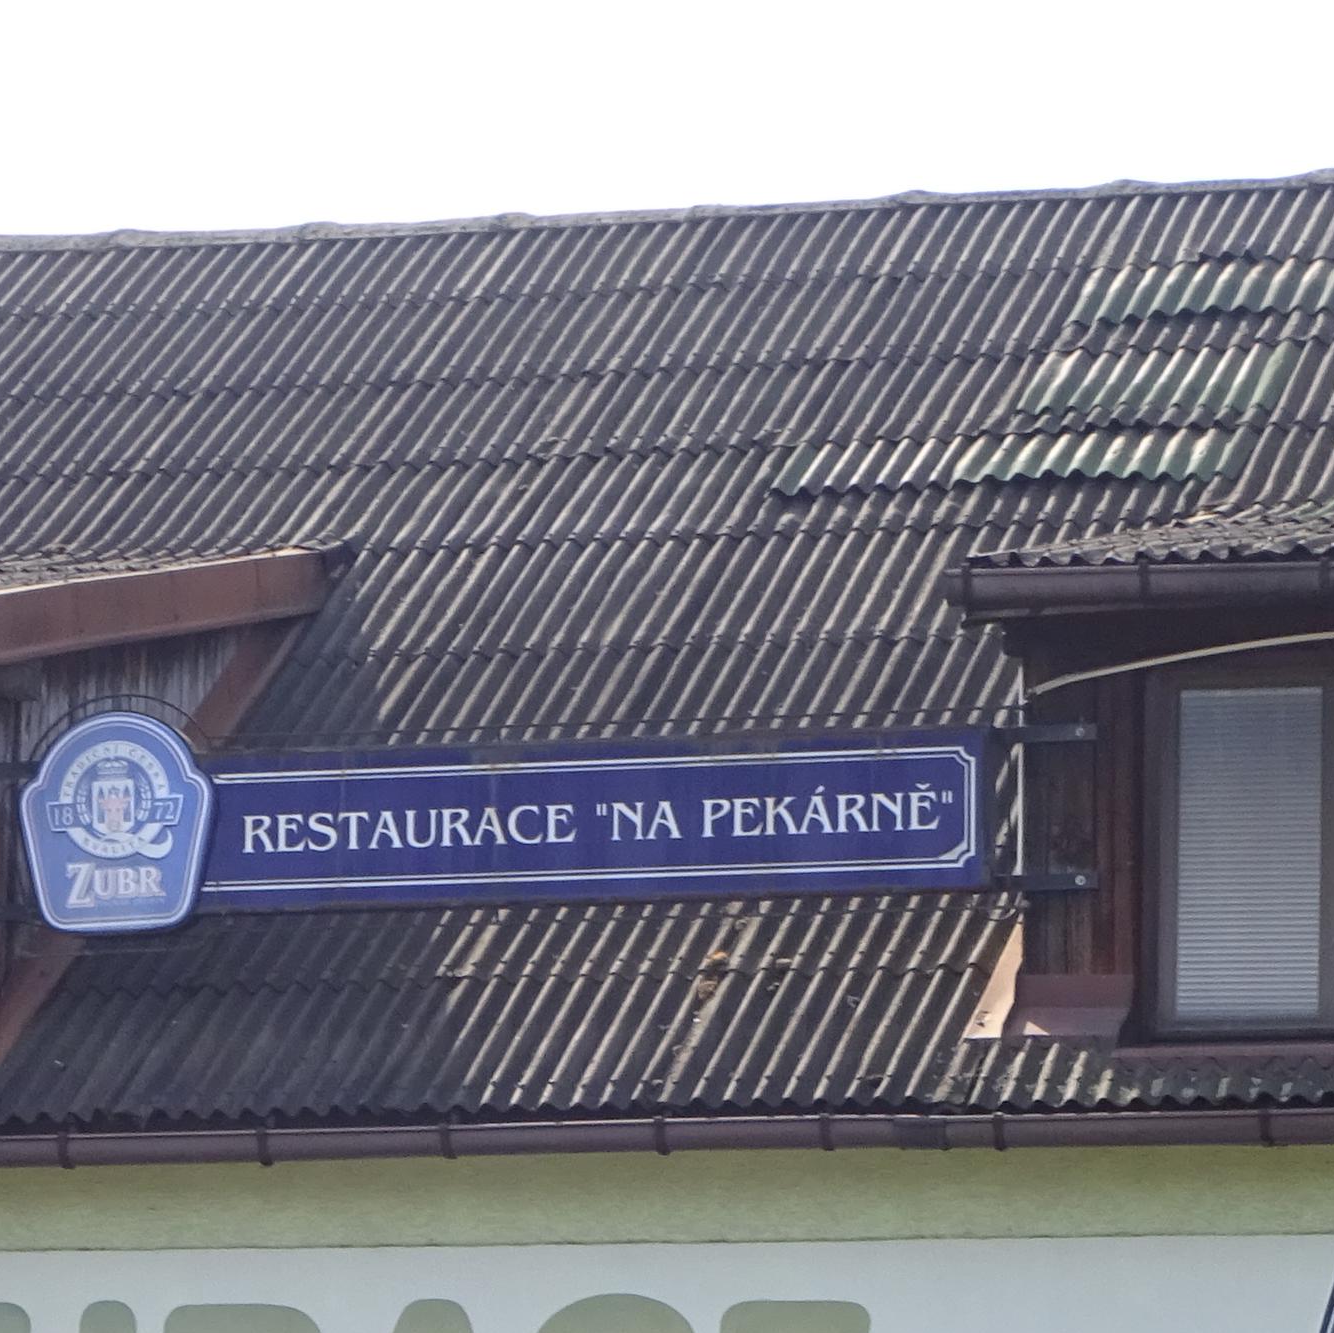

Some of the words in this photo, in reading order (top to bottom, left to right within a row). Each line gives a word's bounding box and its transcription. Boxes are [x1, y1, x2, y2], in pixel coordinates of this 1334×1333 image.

[242, 803, 576, 854] RESTAURACE
[595, 801, 683, 841] "NA
[701, 782, 953, 839] PEKÁRNĚ"
[65, 862, 167, 908] ZUBR
